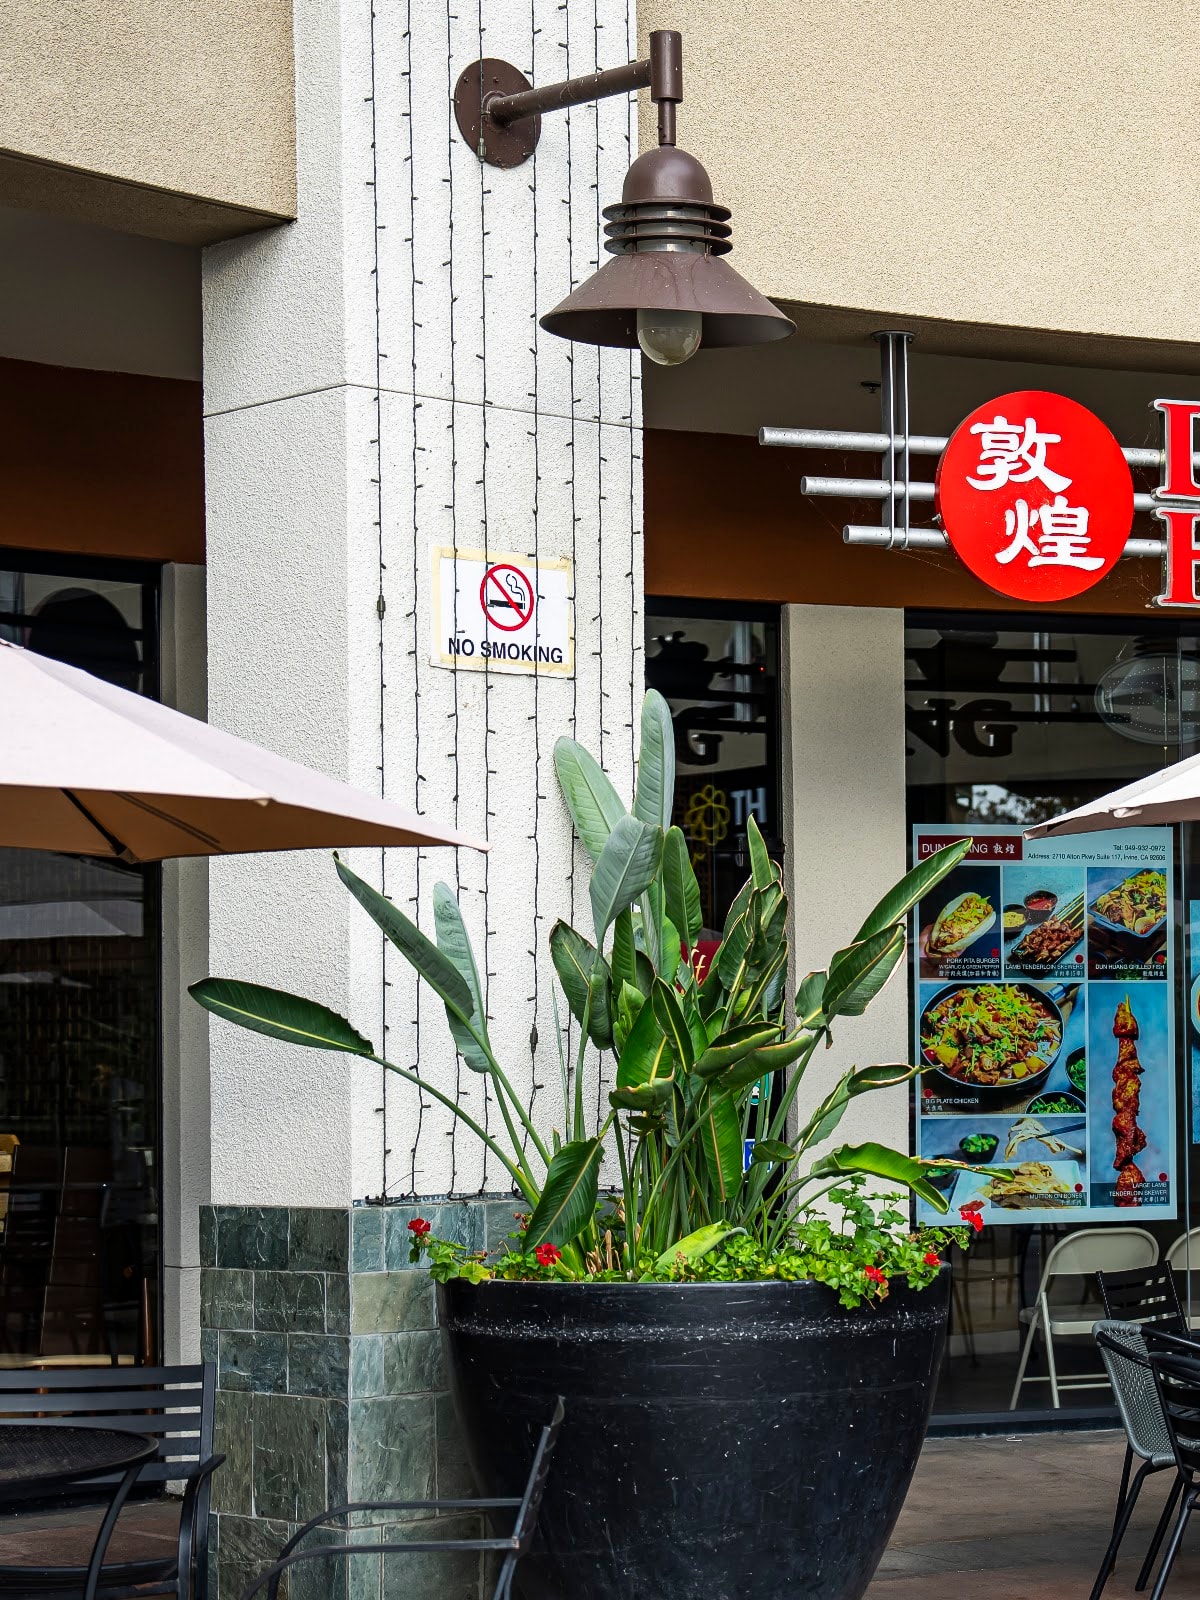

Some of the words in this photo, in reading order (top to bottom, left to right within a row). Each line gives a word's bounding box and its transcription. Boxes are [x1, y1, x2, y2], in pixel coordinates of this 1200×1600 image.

[966, 416, 1106, 571] 敦煌
[448, 638, 475, 657] NO
[480, 641, 563, 664] SMOKING
